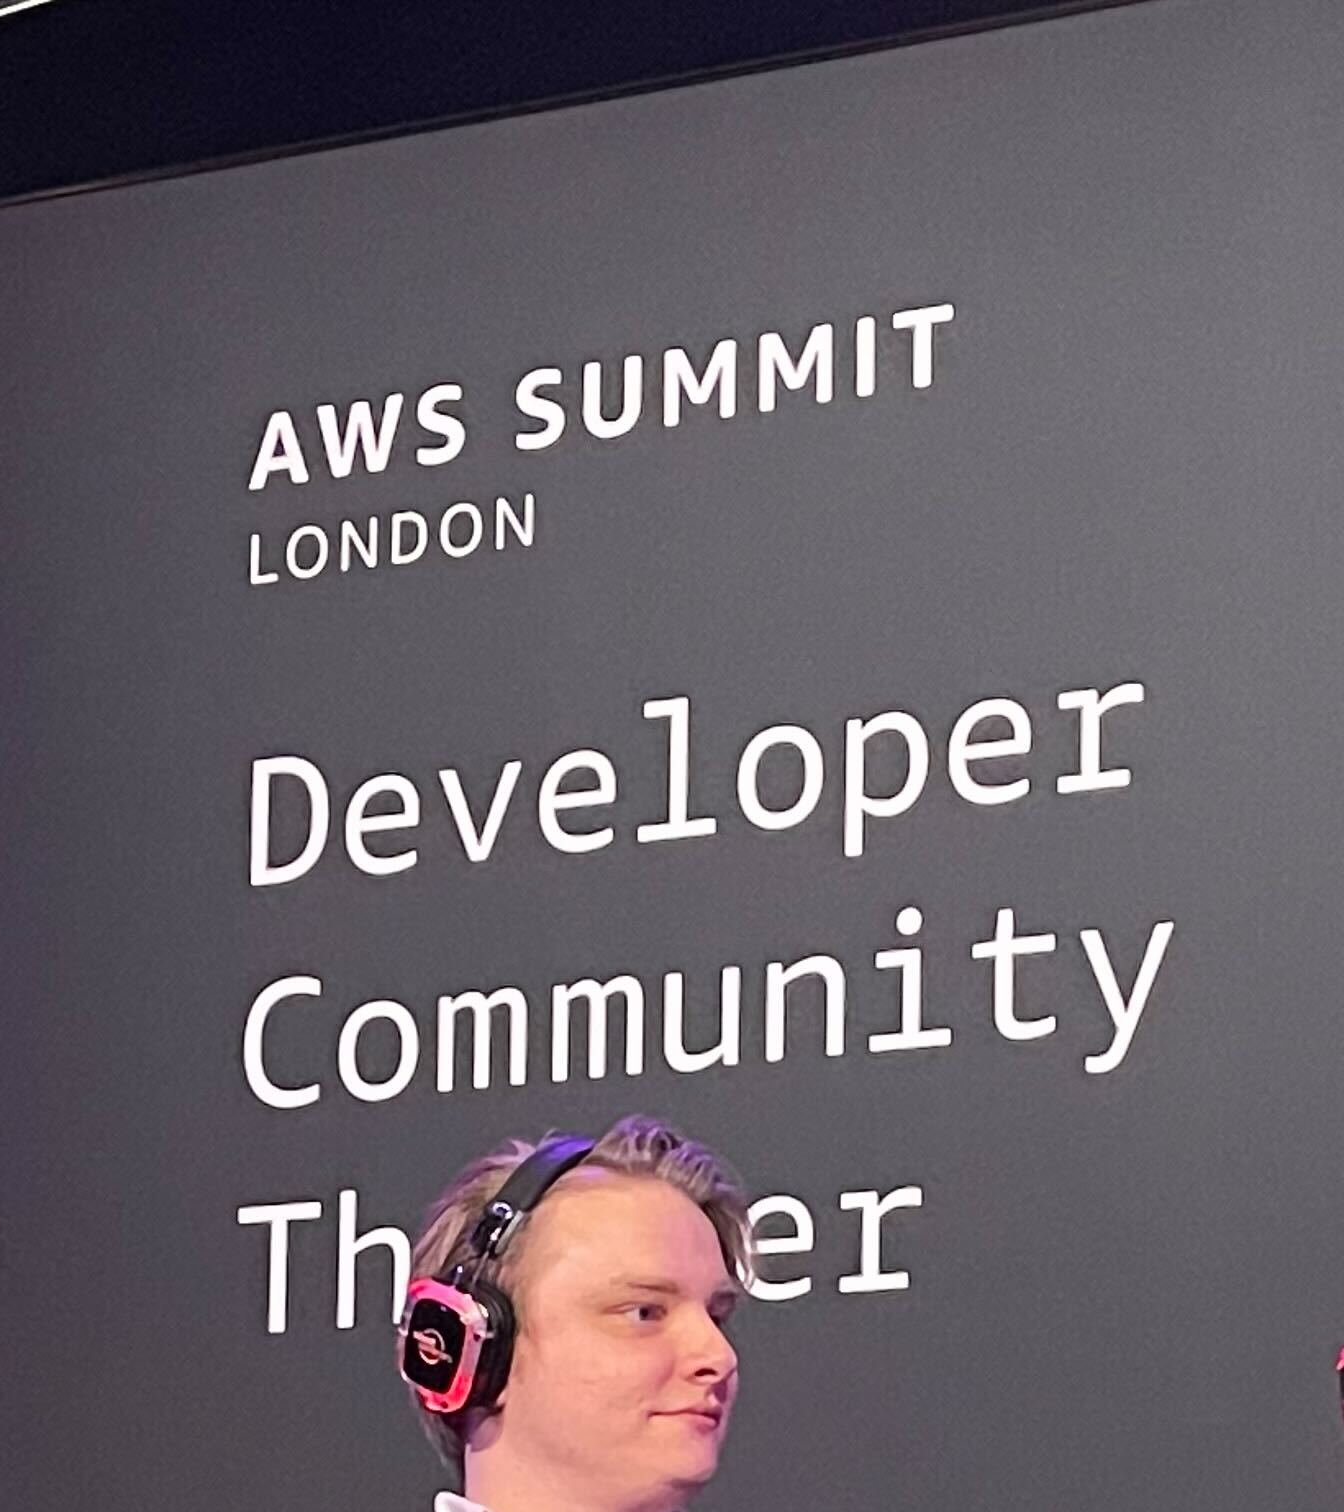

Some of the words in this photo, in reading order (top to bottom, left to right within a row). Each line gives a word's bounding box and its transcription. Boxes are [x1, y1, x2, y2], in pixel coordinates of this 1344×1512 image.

[249, 385, 465, 490] AWS
[516, 304, 954, 449] SUMMIT
[251, 494, 533, 584] LONDON
[251, 684, 1144, 885] Developer
[244, 907, 1174, 1107] Community
[238, 1186, 922, 1333] Ther
